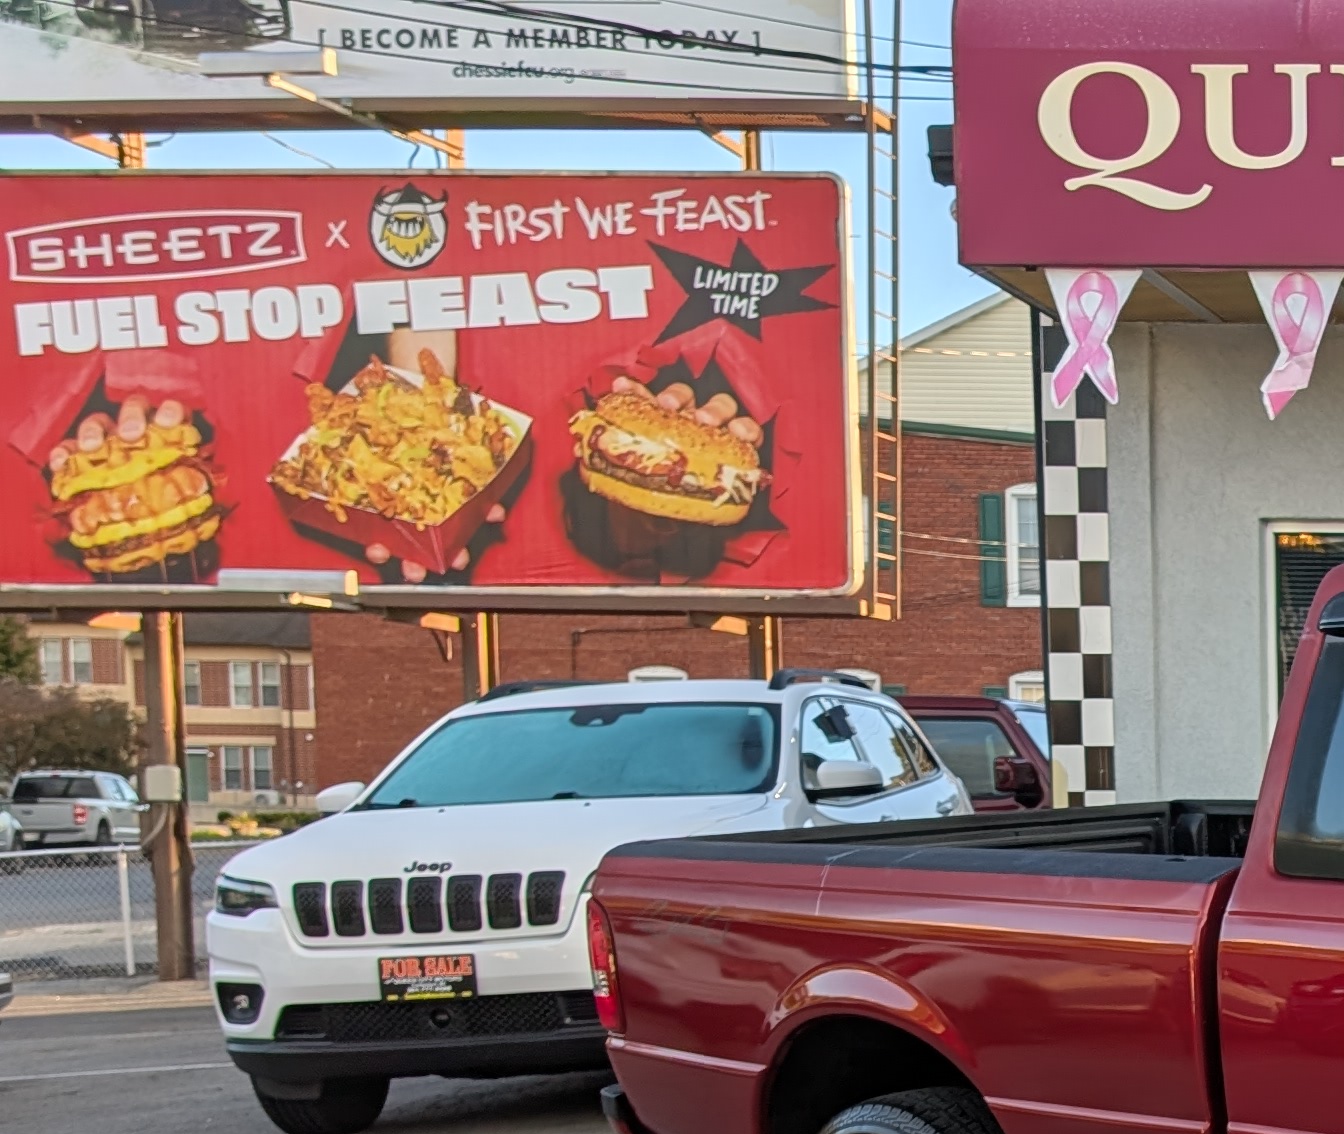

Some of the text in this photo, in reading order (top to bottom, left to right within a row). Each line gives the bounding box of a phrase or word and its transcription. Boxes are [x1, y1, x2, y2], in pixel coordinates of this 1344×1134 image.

[341, 29, 459, 48] BECOME
[474, 29, 492, 48] A
[506, 29, 626, 50] MEMBER
[643, 30, 737, 50] TODAY
[465, 187, 773, 249] FIRST WE FEAST
[28, 222, 283, 271] SHEETZ
[14, 265, 654, 356] FUEL STOP FEAST
[693, 266, 779, 320] LIMITED TIME
[404, 861, 452, 873] Jeep
[381, 956, 473, 979] FOR SALE
